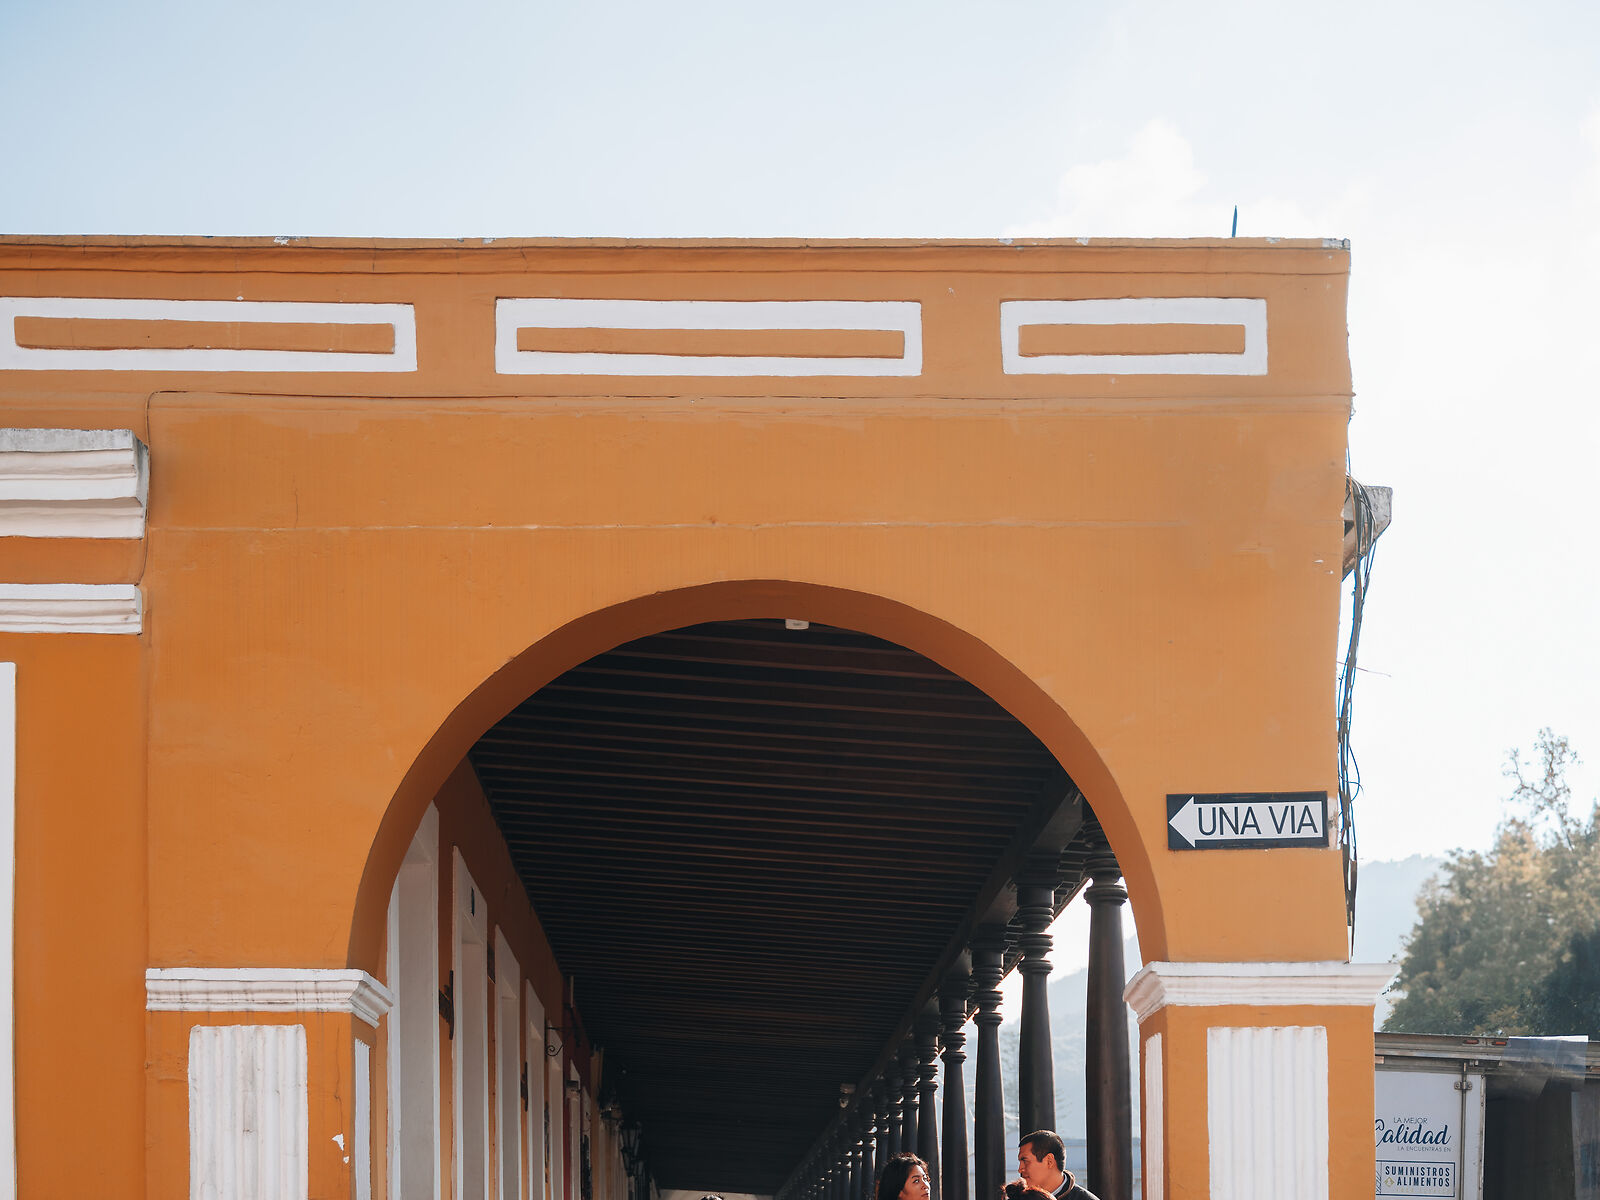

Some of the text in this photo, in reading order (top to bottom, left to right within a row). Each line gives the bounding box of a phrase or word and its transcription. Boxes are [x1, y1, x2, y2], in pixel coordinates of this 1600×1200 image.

[1198, 805, 1318, 836] UNA VIA
[1404, 1117, 1428, 1125] MEJOR
[1385, 1165, 1450, 1177] SUMINISTROS
[1397, 1176, 1450, 1187] ALIMENTOS
